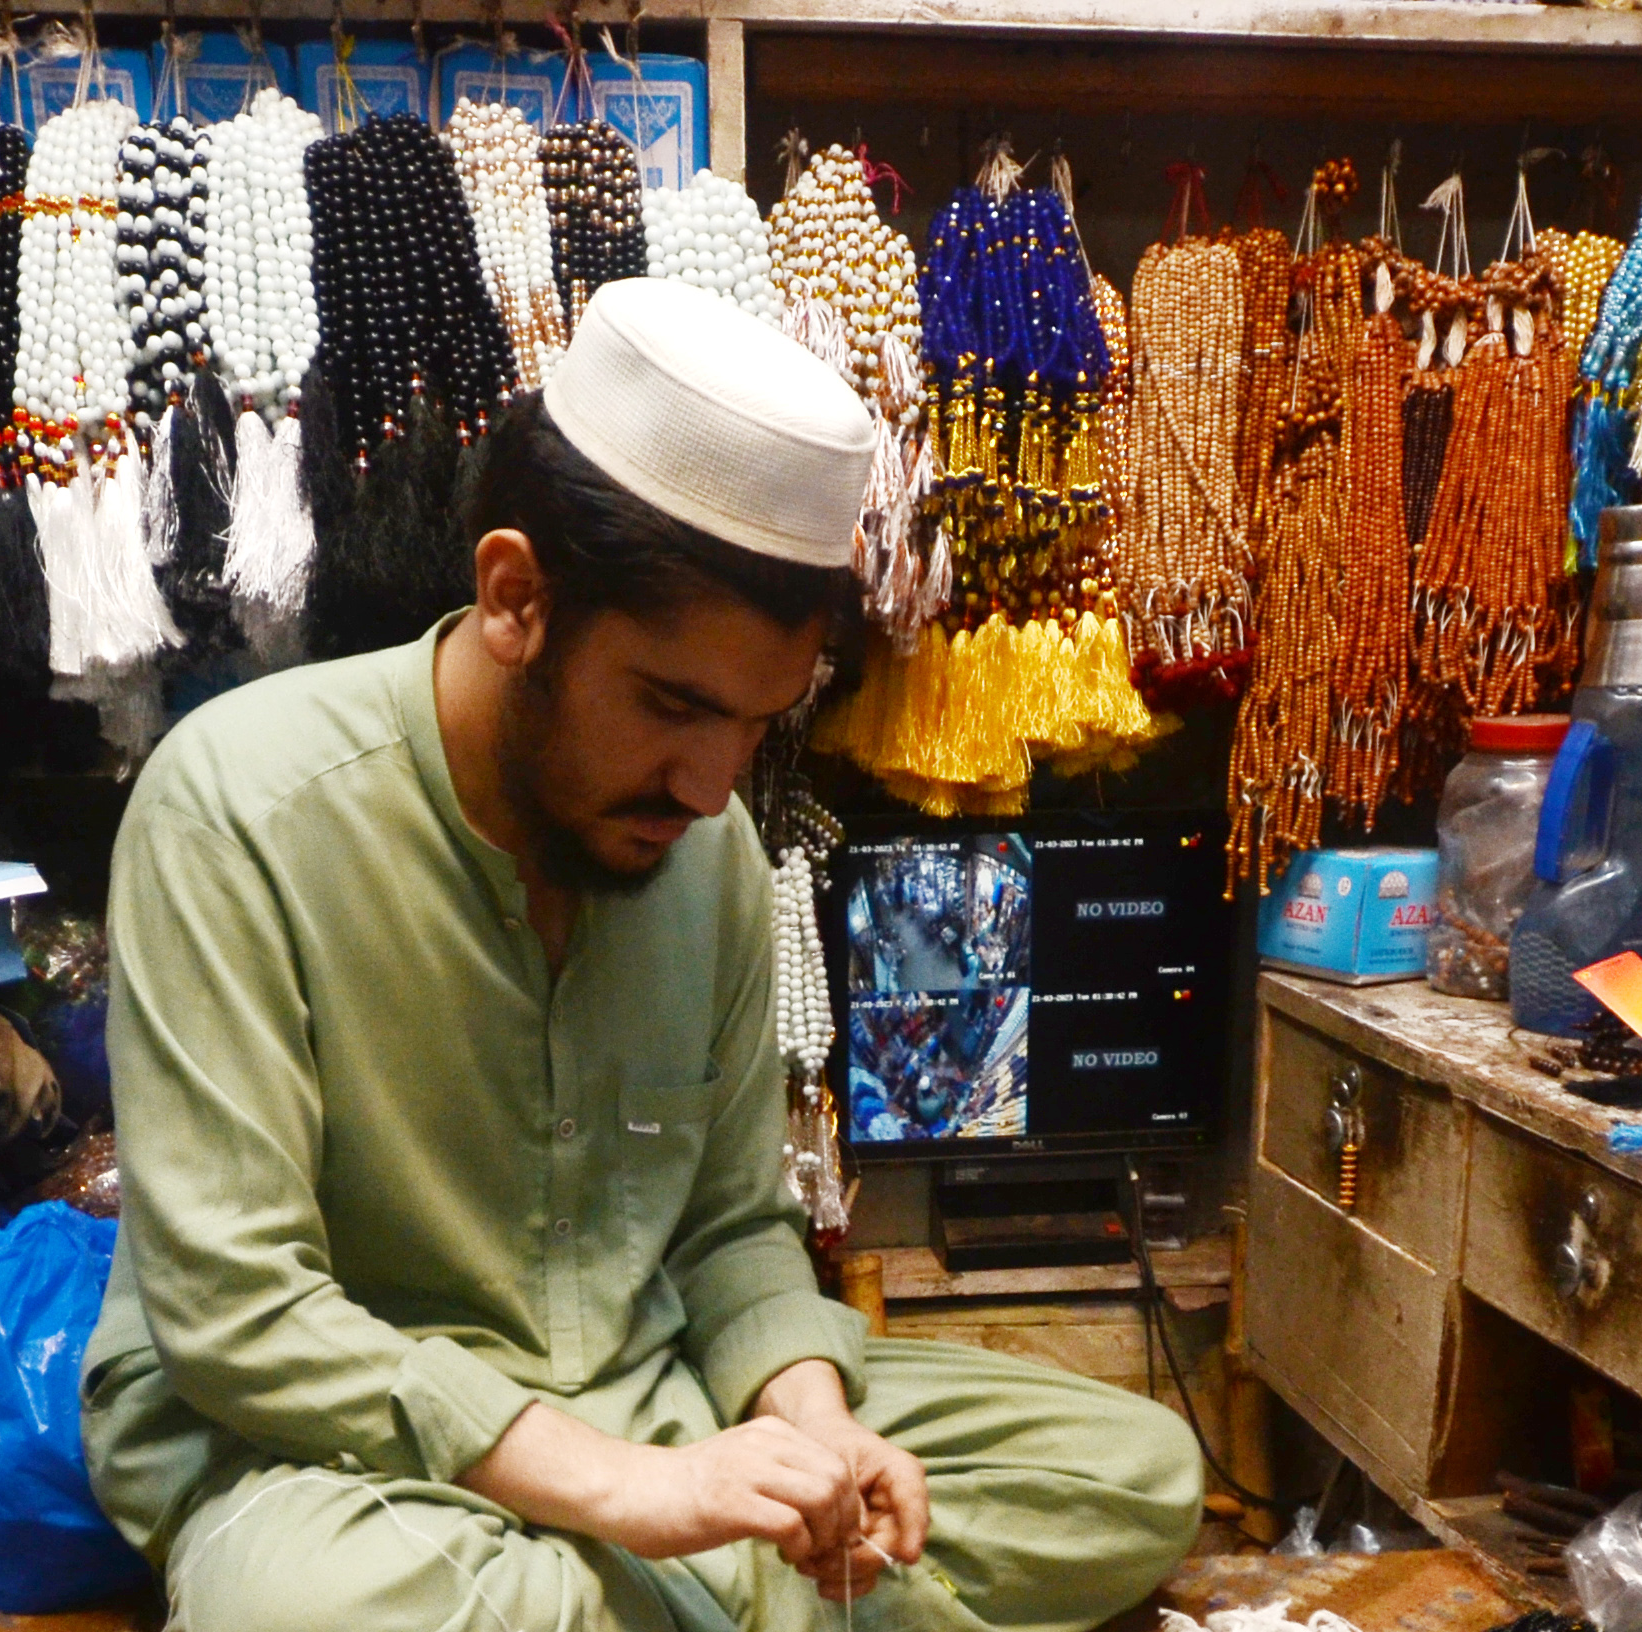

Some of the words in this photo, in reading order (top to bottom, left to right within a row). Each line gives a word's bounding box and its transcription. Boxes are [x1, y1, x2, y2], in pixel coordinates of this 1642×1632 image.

[1077, 903, 1102, 917] NO
[1108, 901, 1164, 916] VIDEO
[1283, 901, 1328, 924] AZAN
[1389, 905, 1434, 926] AZA
[1072, 1053, 1097, 1068] NO
[1103, 1051, 1158, 1066] VIDEO
